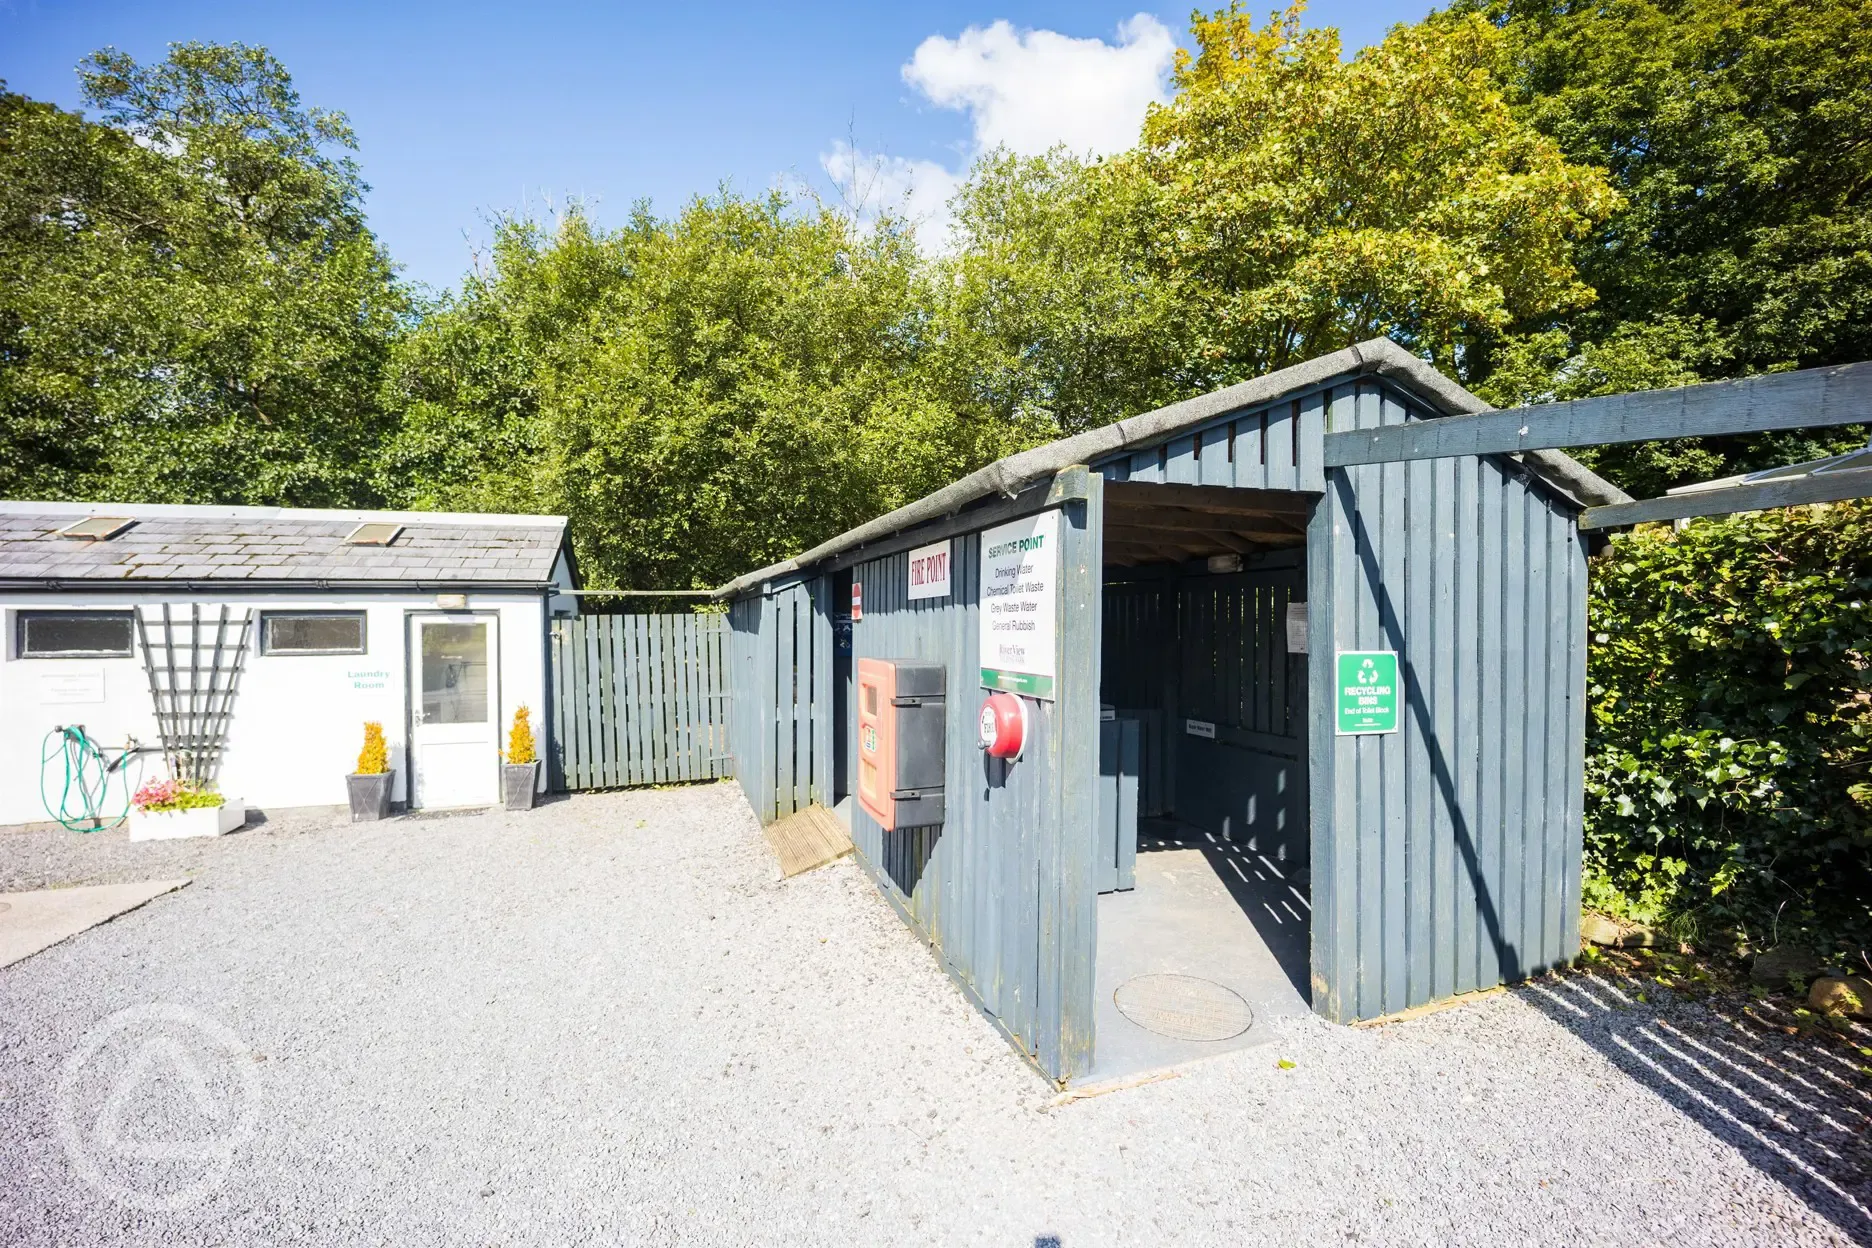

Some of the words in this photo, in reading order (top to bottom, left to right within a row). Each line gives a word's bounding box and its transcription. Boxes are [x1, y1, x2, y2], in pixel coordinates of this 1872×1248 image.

[988, 540, 1017, 559] SERVICE
[1018, 535, 1045, 553] POINT
[912, 558, 925, 586] FIRE
[926, 552, 946, 584] POINT
[995, 567, 1016, 579] Drinking
[1017, 563, 1033, 575] Water
[986, 584, 1009, 597] Chemical
[1010, 582, 1024, 594] Toilet
[1025, 580, 1044, 593] Waste
[990, 603, 1002, 615] Grey
[1003, 602, 1019, 612] Waste
[1020, 601, 1037, 612] Water
[992, 620, 1011, 631] General
[1012, 620, 1035, 631] Rubbish
[348, 670, 390, 679] Laundry
[354, 681, 385, 689] Room
[1344, 686, 1391, 696] RECYCLING
[1358, 696, 1378, 705] BINS
